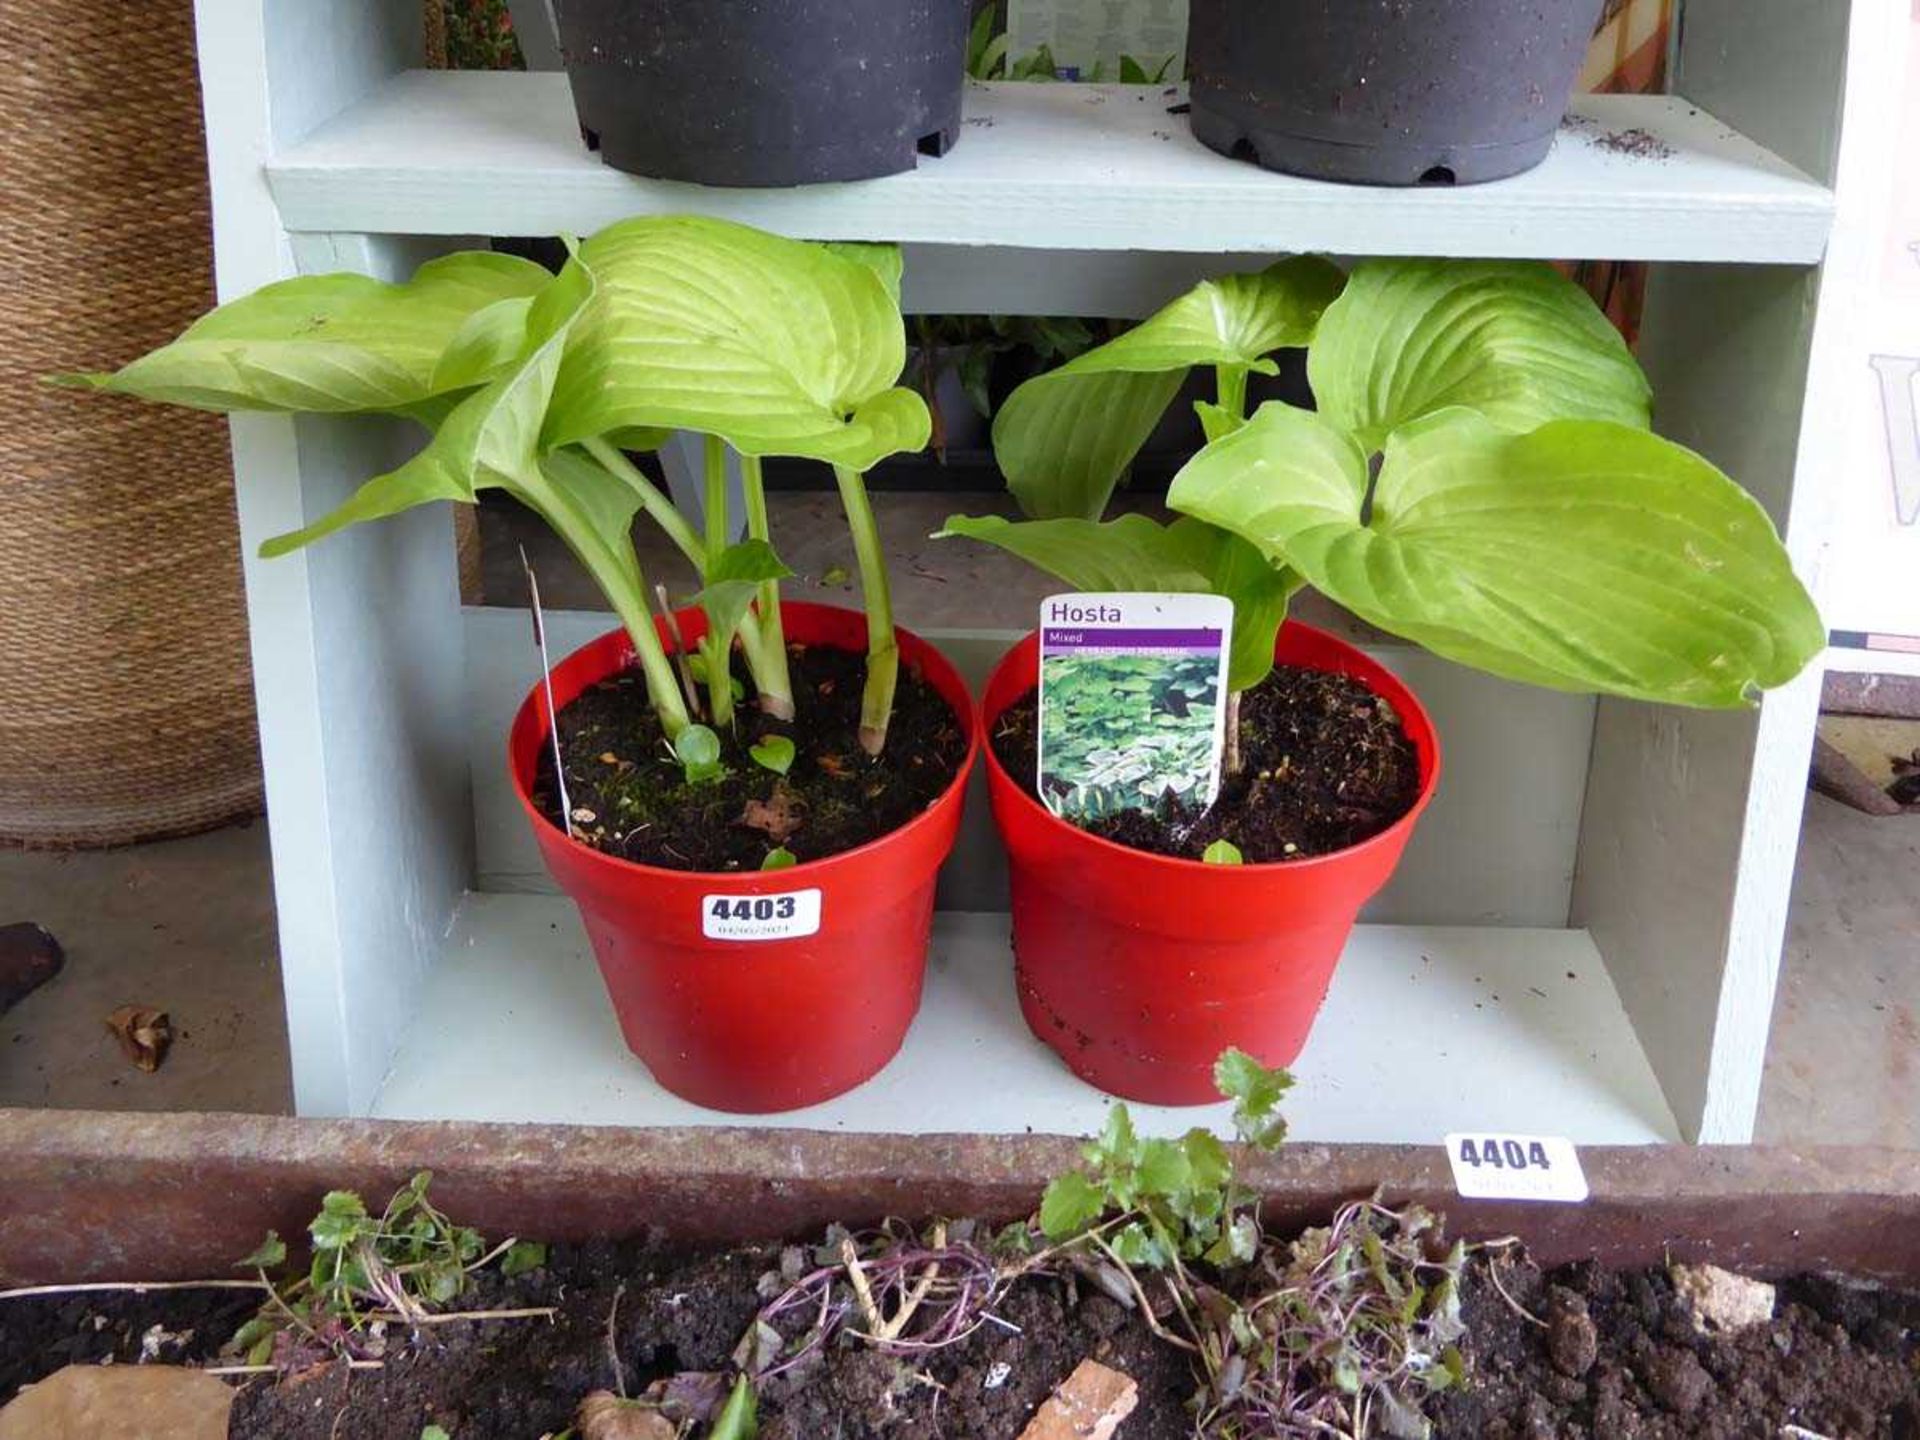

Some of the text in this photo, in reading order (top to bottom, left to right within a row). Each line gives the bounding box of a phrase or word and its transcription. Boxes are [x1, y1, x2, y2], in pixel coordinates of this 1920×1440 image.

[1051, 602, 1122, 623] Hosta
[1049, 631, 1083, 644] Mixed
[711, 896, 796, 921] 4403
[1459, 1138, 1551, 1170] 4404
